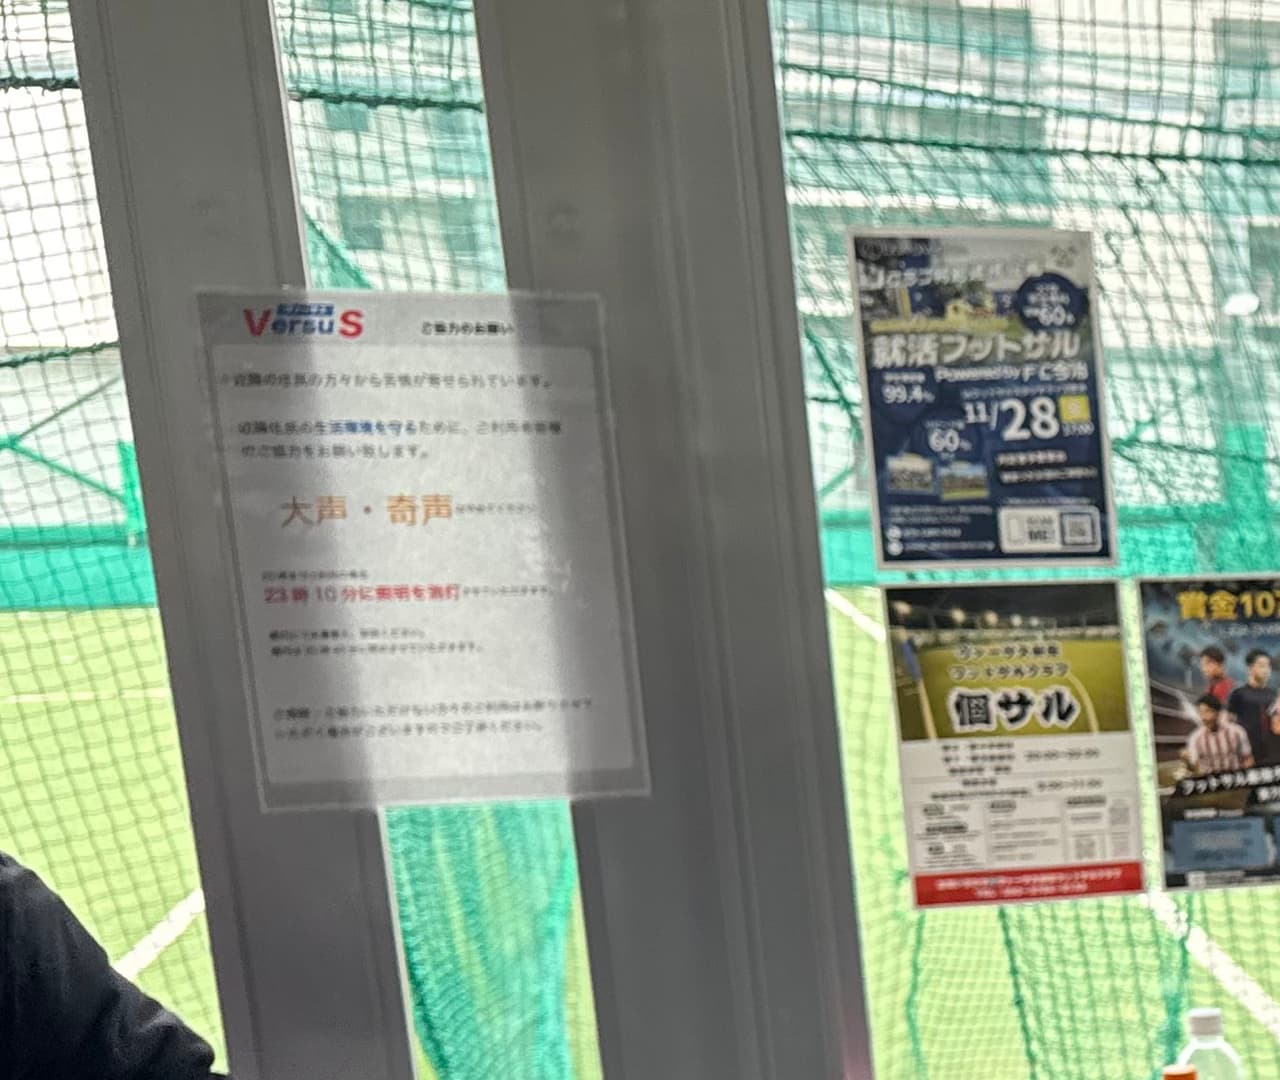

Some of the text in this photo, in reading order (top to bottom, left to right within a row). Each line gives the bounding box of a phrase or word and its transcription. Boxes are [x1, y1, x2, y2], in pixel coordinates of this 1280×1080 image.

[872, 332, 1081, 368] 就活フットサル
[280, 494, 453, 528] 大声・奇声
[954, 690, 1075, 727] 個サル
